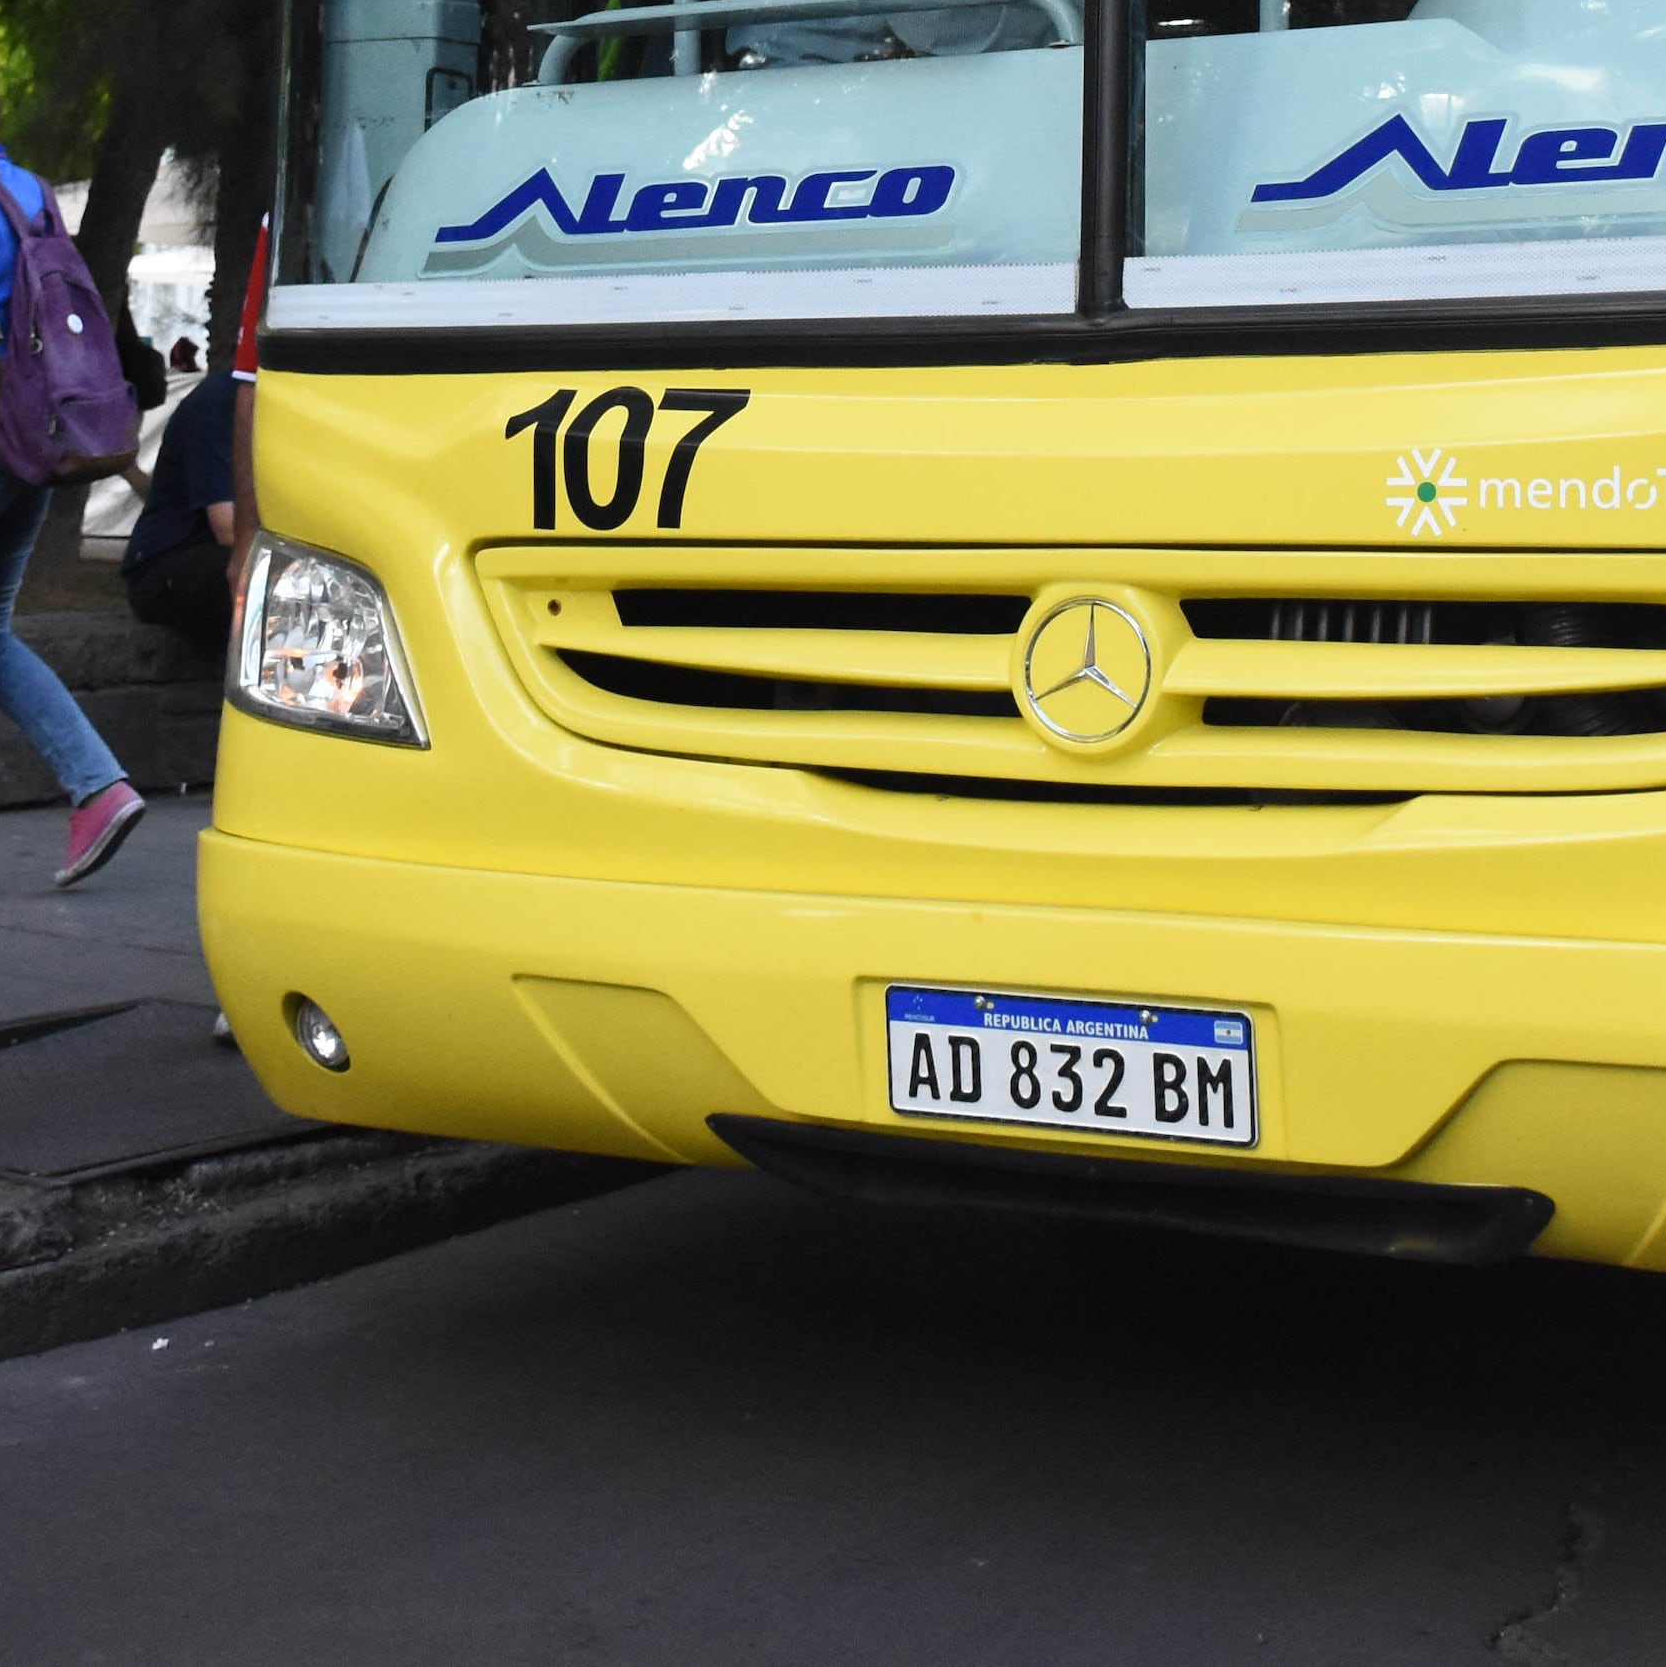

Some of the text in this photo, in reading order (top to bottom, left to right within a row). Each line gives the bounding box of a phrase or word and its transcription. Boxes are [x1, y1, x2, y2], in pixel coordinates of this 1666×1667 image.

[505, 386, 751, 532] 107
[1065, 1018, 1150, 1041] ARGENTINA
[908, 1032, 1234, 1129] AD 832 BM
